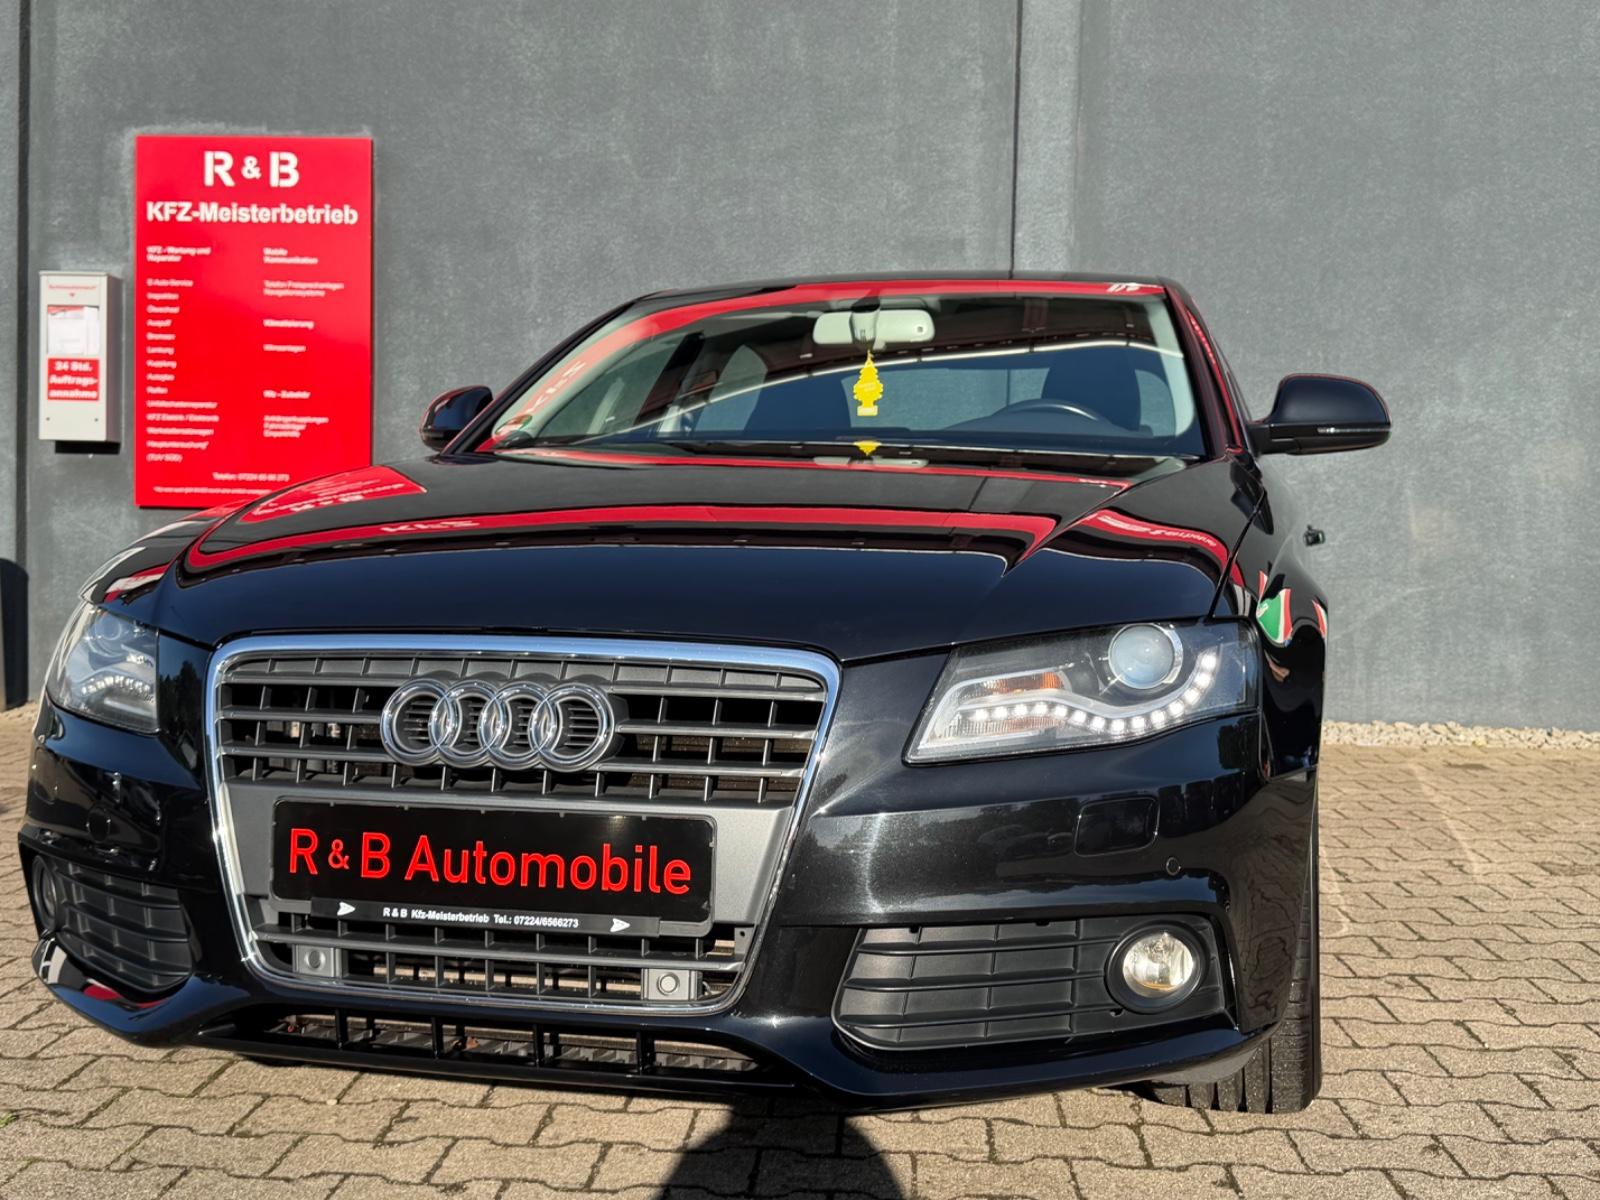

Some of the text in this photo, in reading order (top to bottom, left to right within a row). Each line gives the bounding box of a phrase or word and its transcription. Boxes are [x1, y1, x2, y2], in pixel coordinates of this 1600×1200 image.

[204, 151, 300, 188] R & B
[146, 200, 359, 225] KFZ-Meisterbetrieb
[289, 828, 691, 895] R & B Automobile
[383, 907, 391, 917] R
[391, 908, 399, 918] &
[400, 908, 408, 918] B
[411, 909, 490, 924] Kfz-Meisterbetrieb
